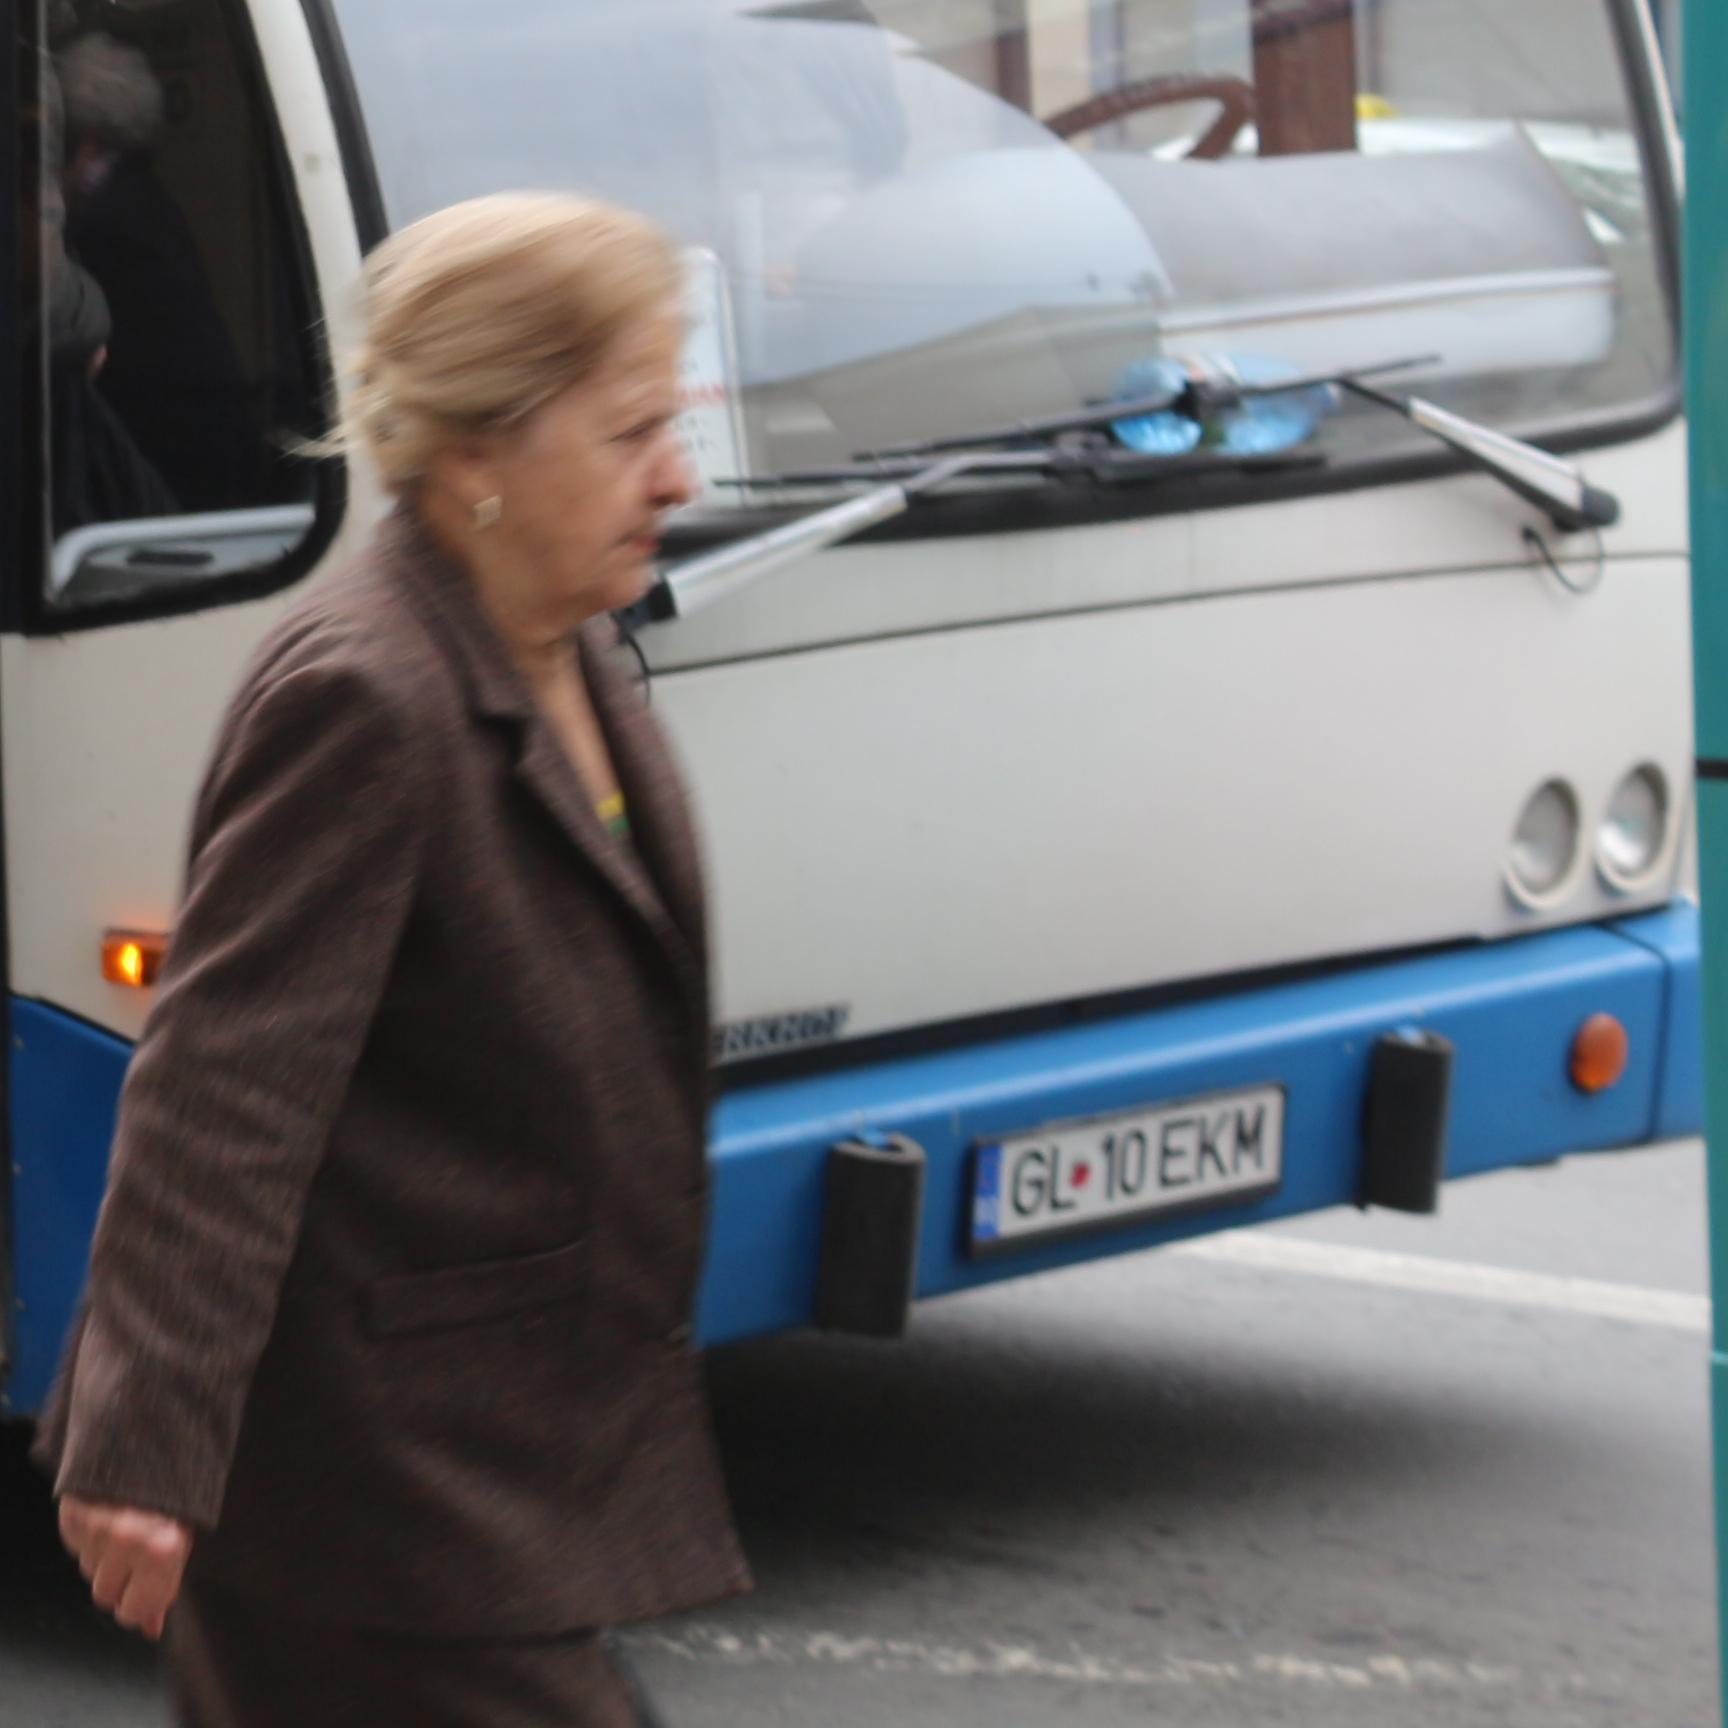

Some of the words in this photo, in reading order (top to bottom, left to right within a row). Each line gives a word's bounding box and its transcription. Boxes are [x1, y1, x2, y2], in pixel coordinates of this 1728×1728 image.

[1011, 1146, 1075, 1216] GL
[1101, 1129, 1147, 1199] 10
[1157, 1104, 1265, 1188] EKM
